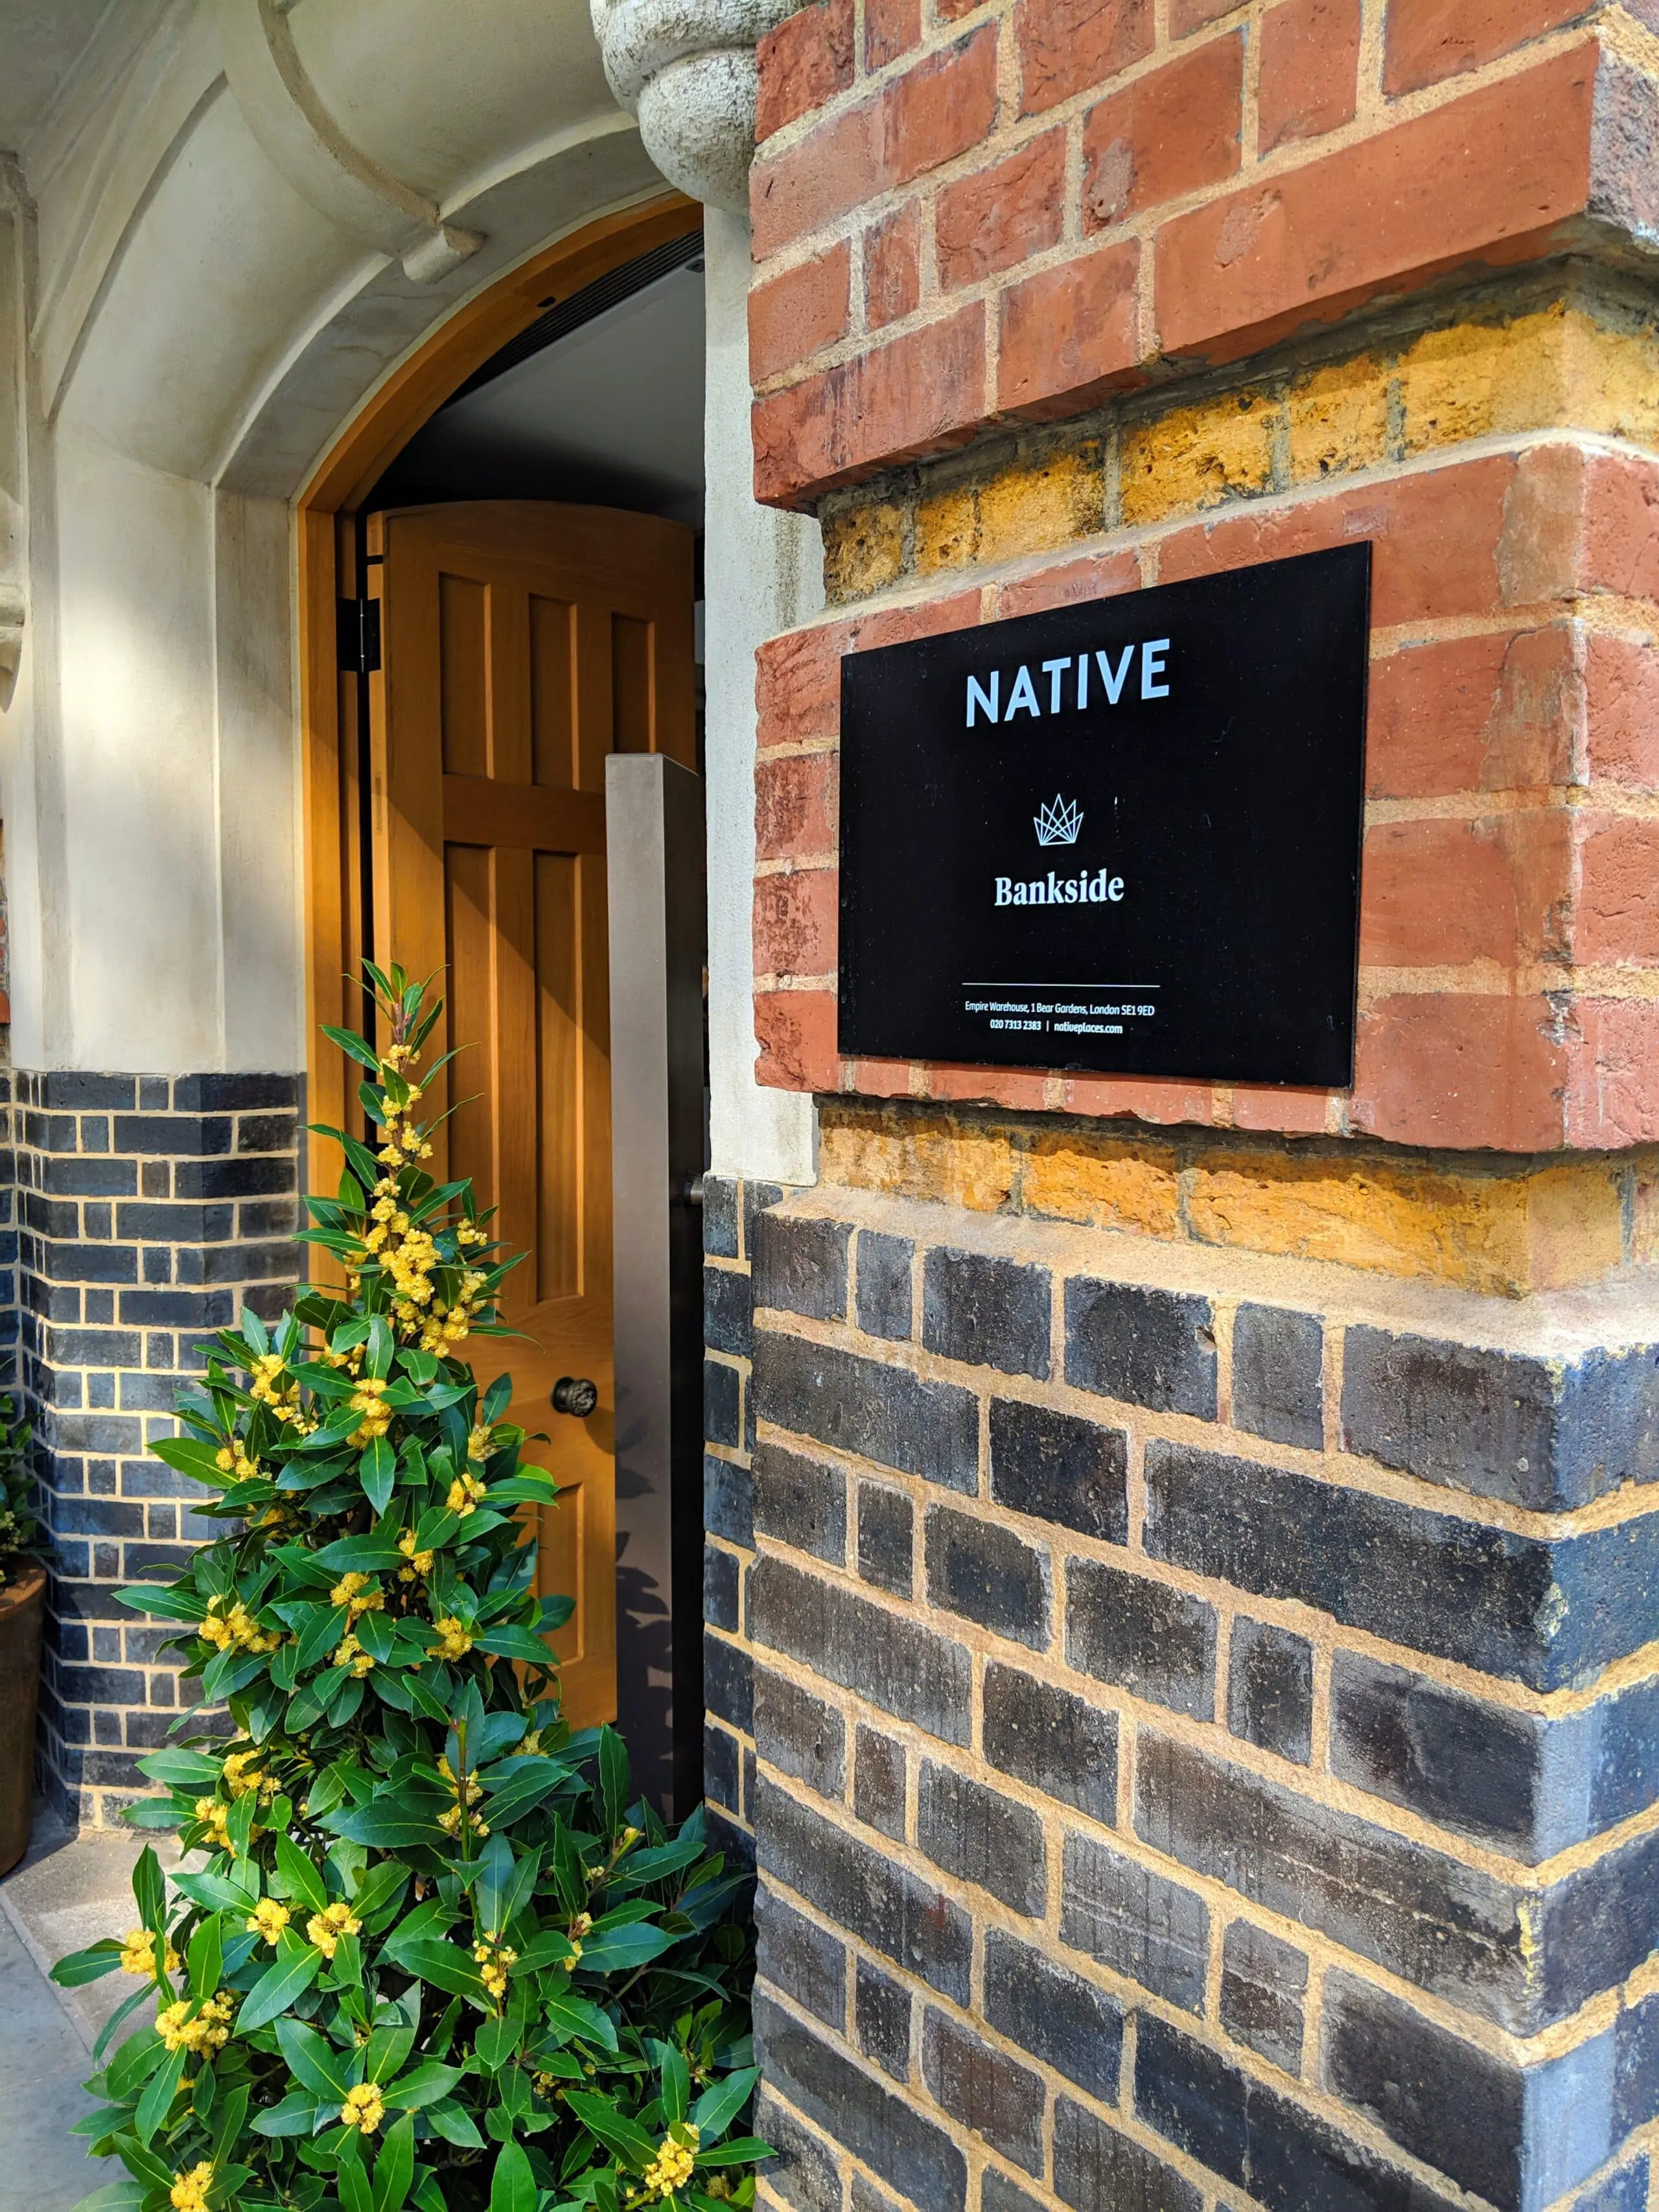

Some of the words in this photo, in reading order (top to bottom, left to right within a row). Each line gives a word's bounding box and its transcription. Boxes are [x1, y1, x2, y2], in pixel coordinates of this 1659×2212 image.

[966, 638, 1170, 728] NATIVE
[994, 868, 1124, 906] Bankside
[965, 1001, 989, 1013] Empire
[989, 1001, 1030, 1013] Warehouse,
[1030, 1003, 1036, 1013] 1
[1036, 1003, 1054, 1013] Bear
[1054, 1003, 1089, 1016] Gardens,
[1089, 1004, 1120, 1015] London
[1120, 1005, 1136, 1016] SE1
[1137, 1005, 1155, 1016] 9ED
[990, 1019, 1004, 1029] 020
[1004, 1019, 1022, 1030] 7313
[1023, 1020, 1042, 1030] 2383
[1054, 1021, 1123, 1035] nativeplaces.com
